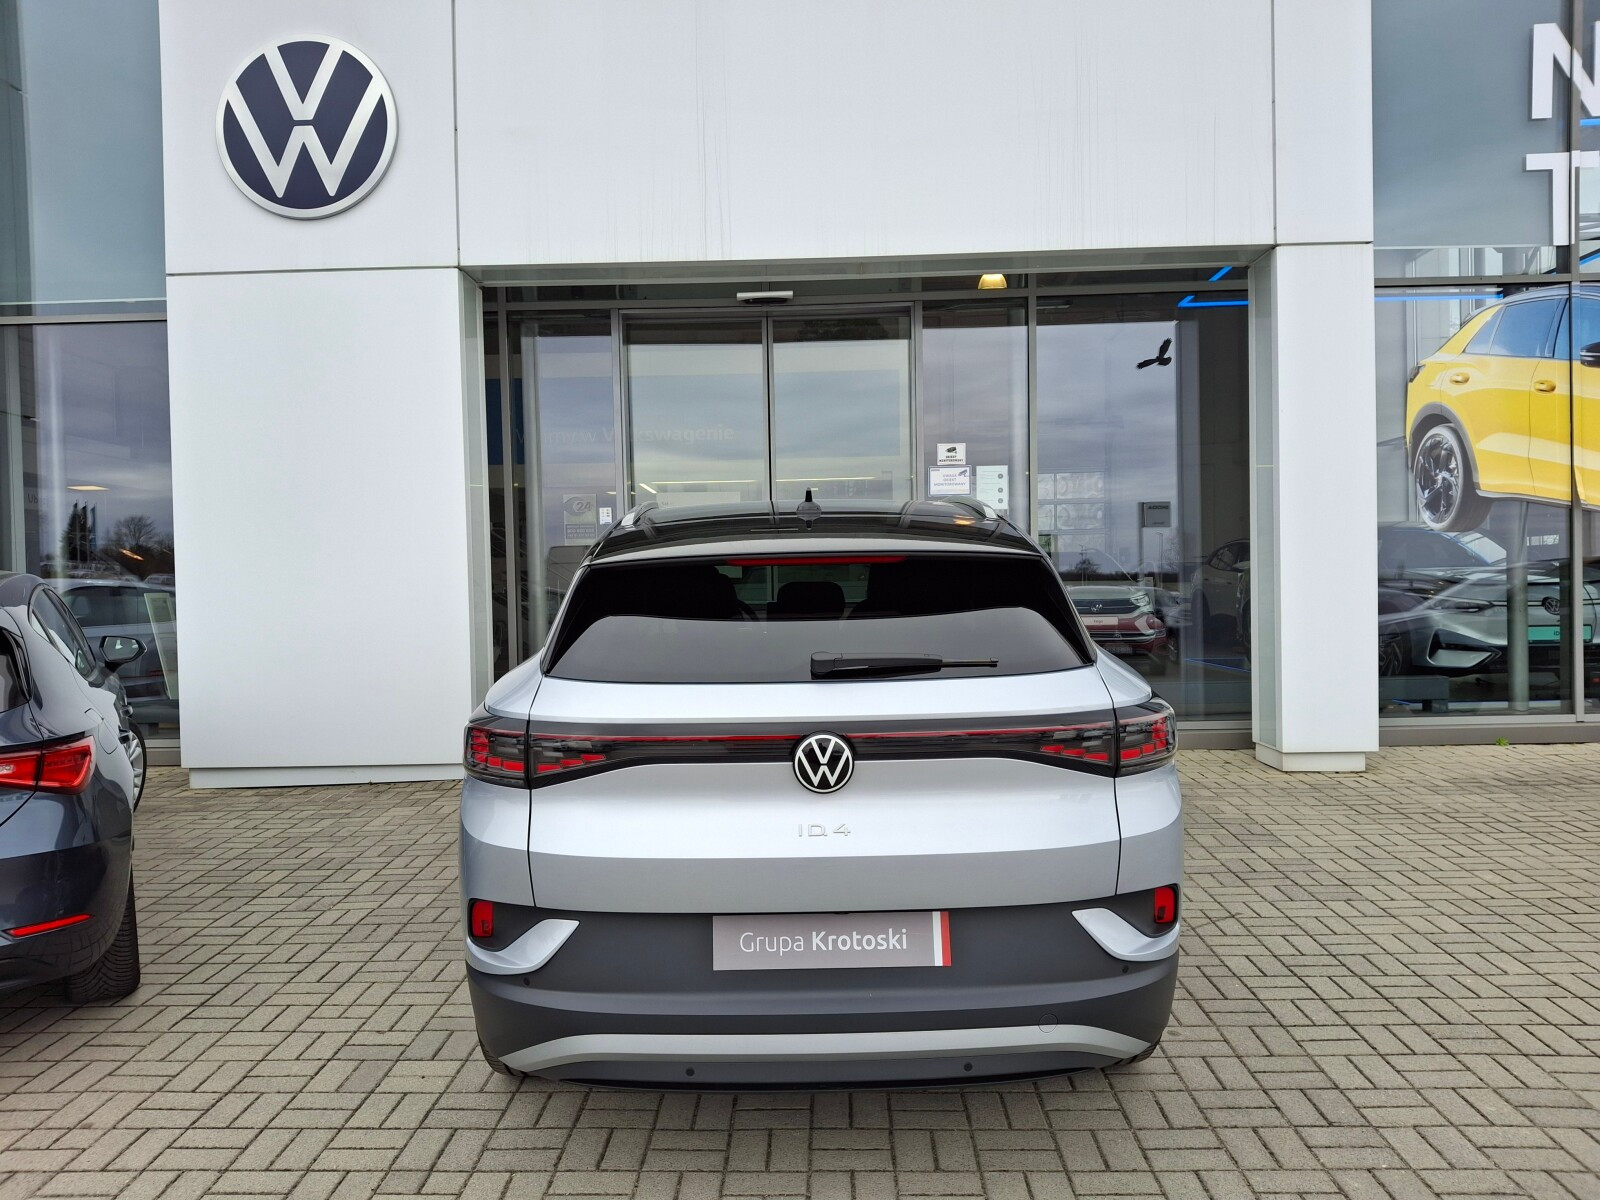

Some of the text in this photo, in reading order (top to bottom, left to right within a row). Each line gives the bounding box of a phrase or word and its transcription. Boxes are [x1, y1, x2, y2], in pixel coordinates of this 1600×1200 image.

[222, 40, 392, 205] VW
[796, 735, 853, 788] VW
[739, 927, 908, 956] Grupa Krotoski
